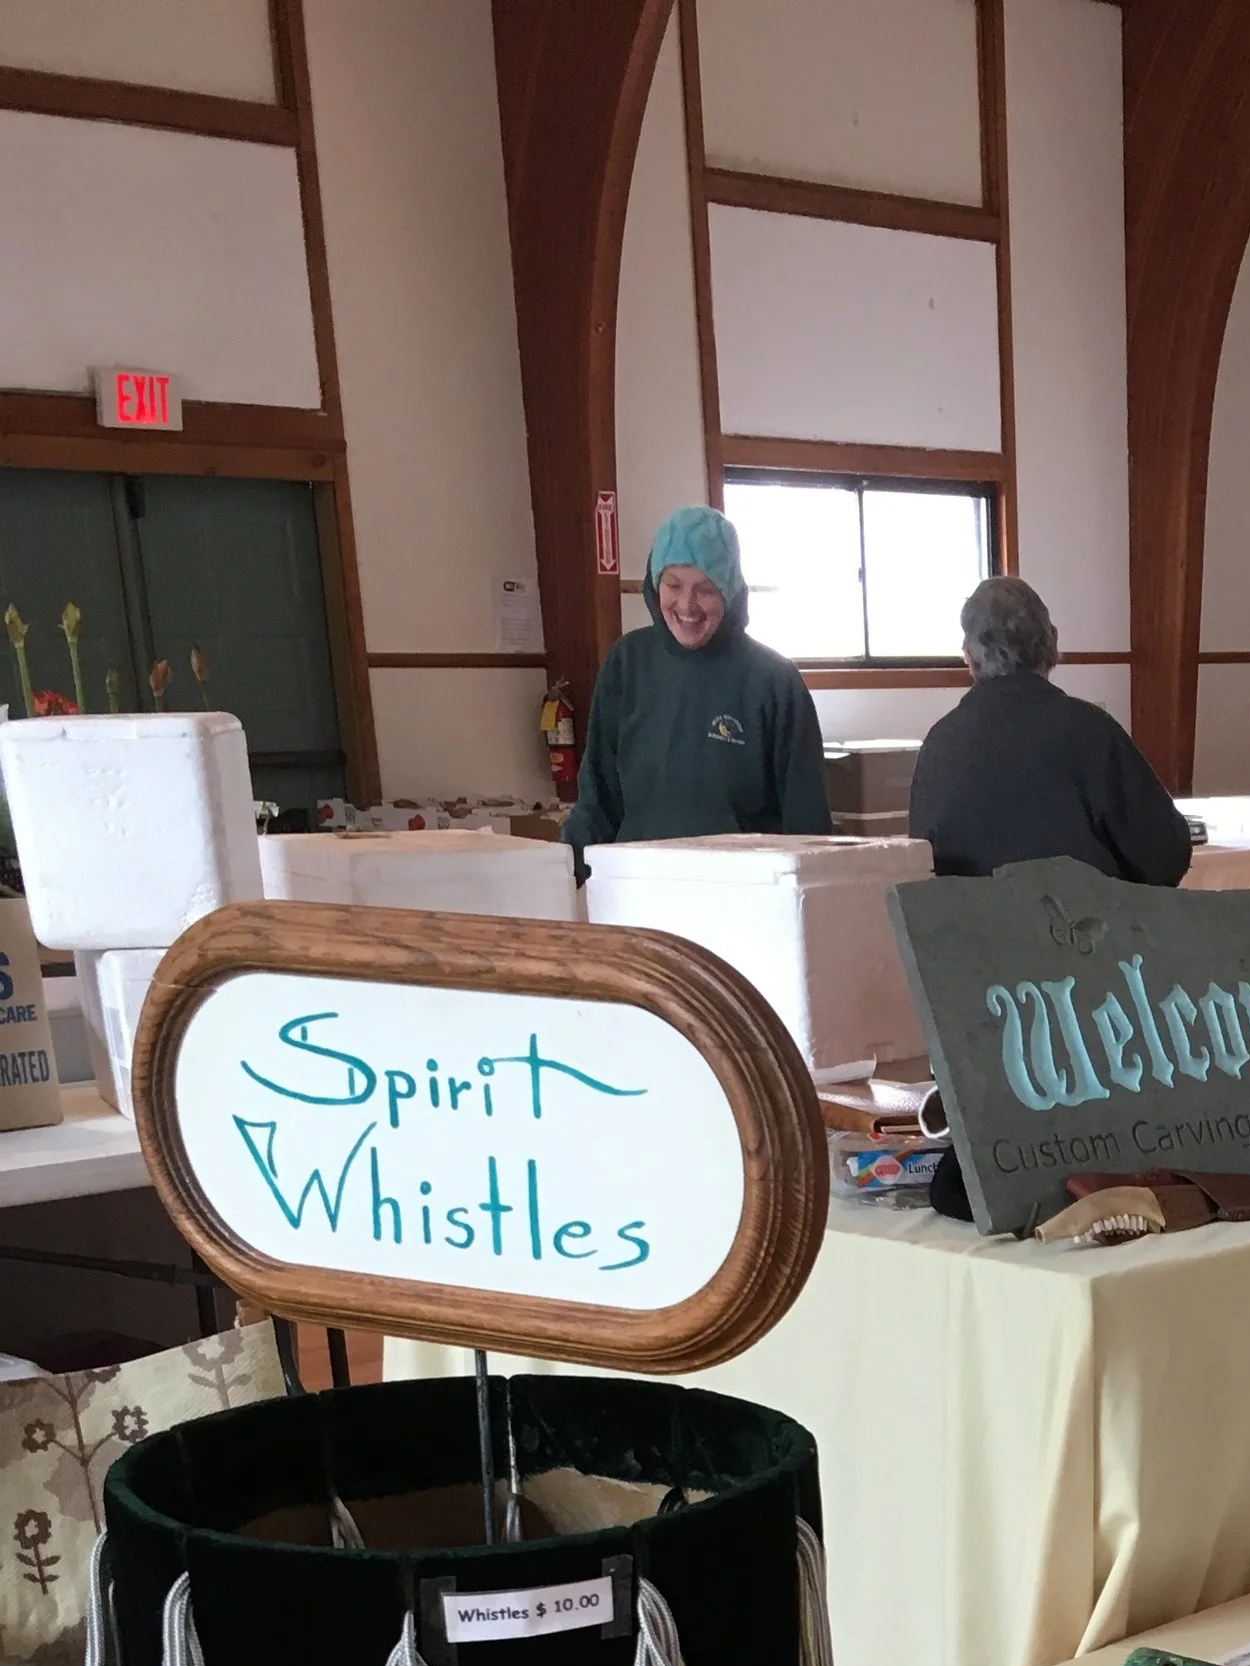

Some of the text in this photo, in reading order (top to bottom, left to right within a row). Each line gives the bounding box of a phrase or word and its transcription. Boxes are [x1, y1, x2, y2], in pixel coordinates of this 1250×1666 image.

[116, 374, 169, 424] EXIT
[240, 1012, 648, 1128] Spirit
[992, 1129, 1120, 1174] Custom
[231, 1114, 650, 1270] Whistles
[458, 1593, 600, 1622] Whistles $ 10.00
